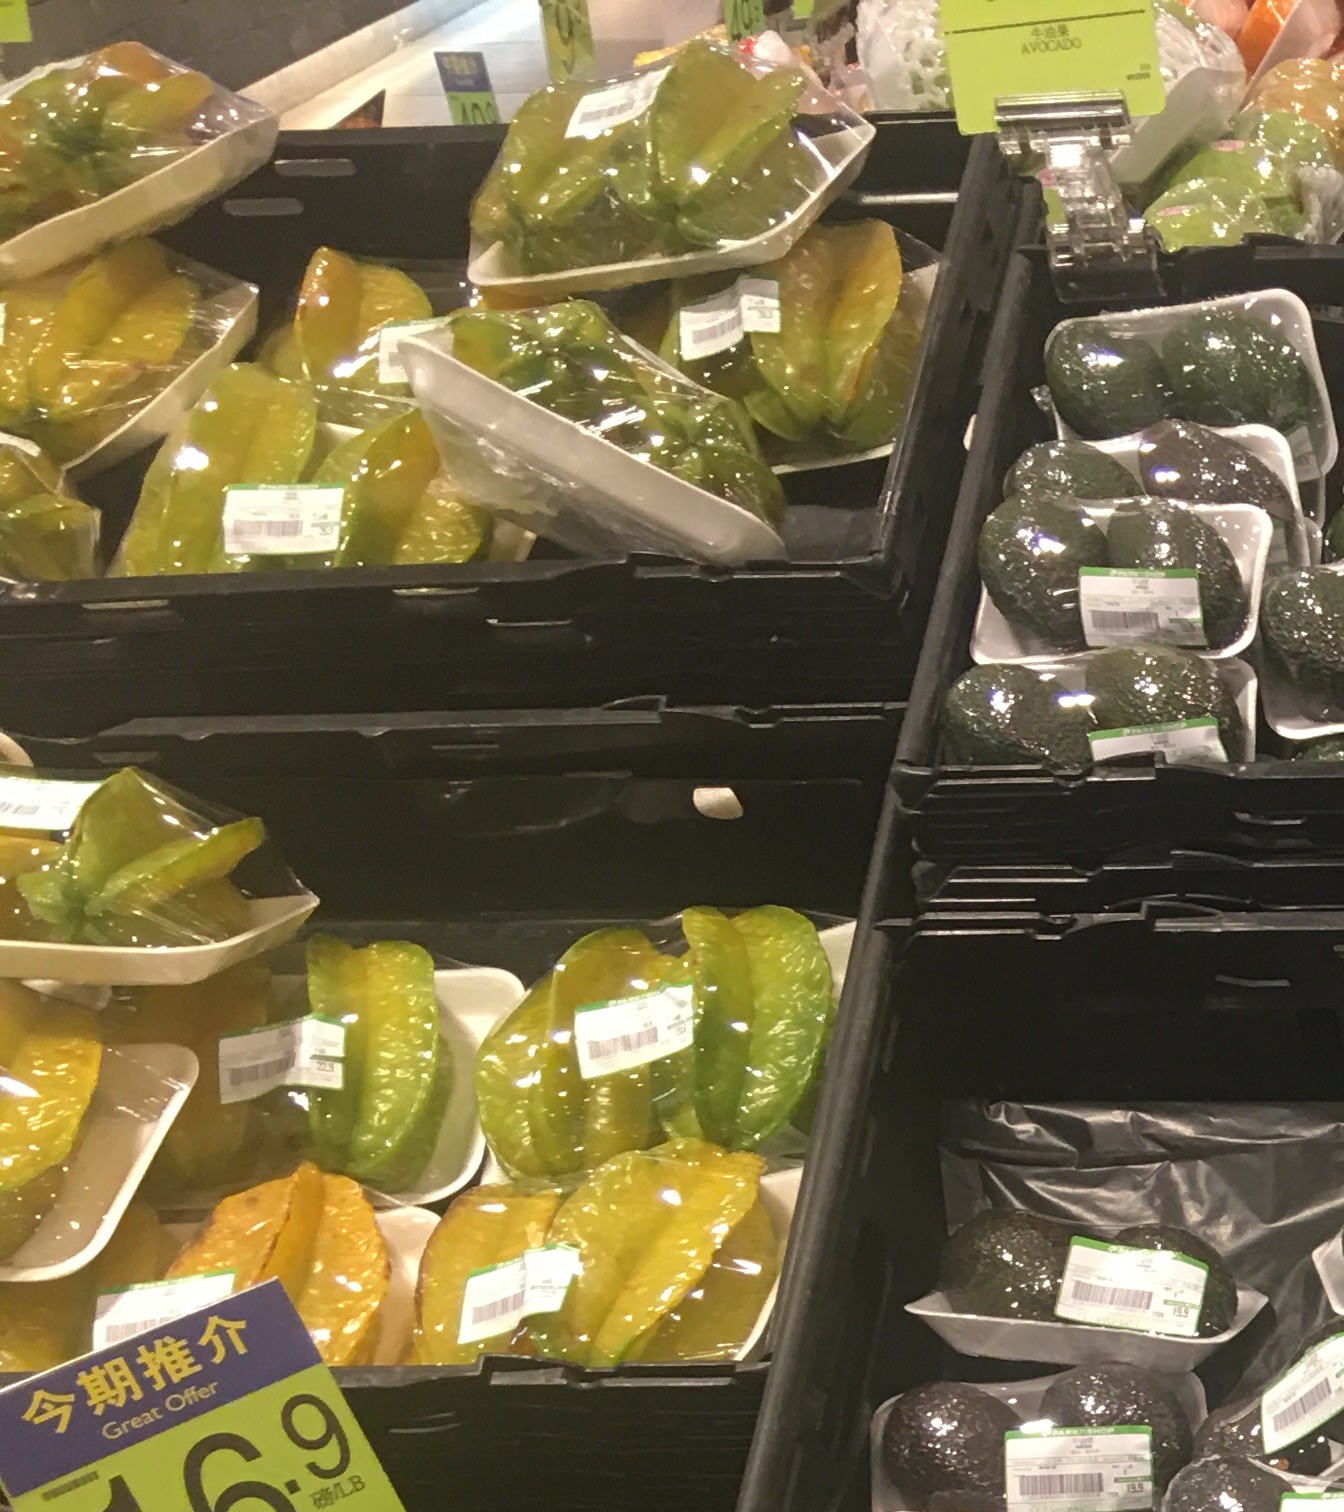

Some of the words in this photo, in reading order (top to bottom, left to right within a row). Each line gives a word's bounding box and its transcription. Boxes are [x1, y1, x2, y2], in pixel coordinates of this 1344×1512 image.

[1021, 37, 1082, 55] AVOCADO
[20, 1313, 248, 1434] 今期推介
[101, 1407, 163, 1441] Great
[164, 1379, 219, 1413] Offer
